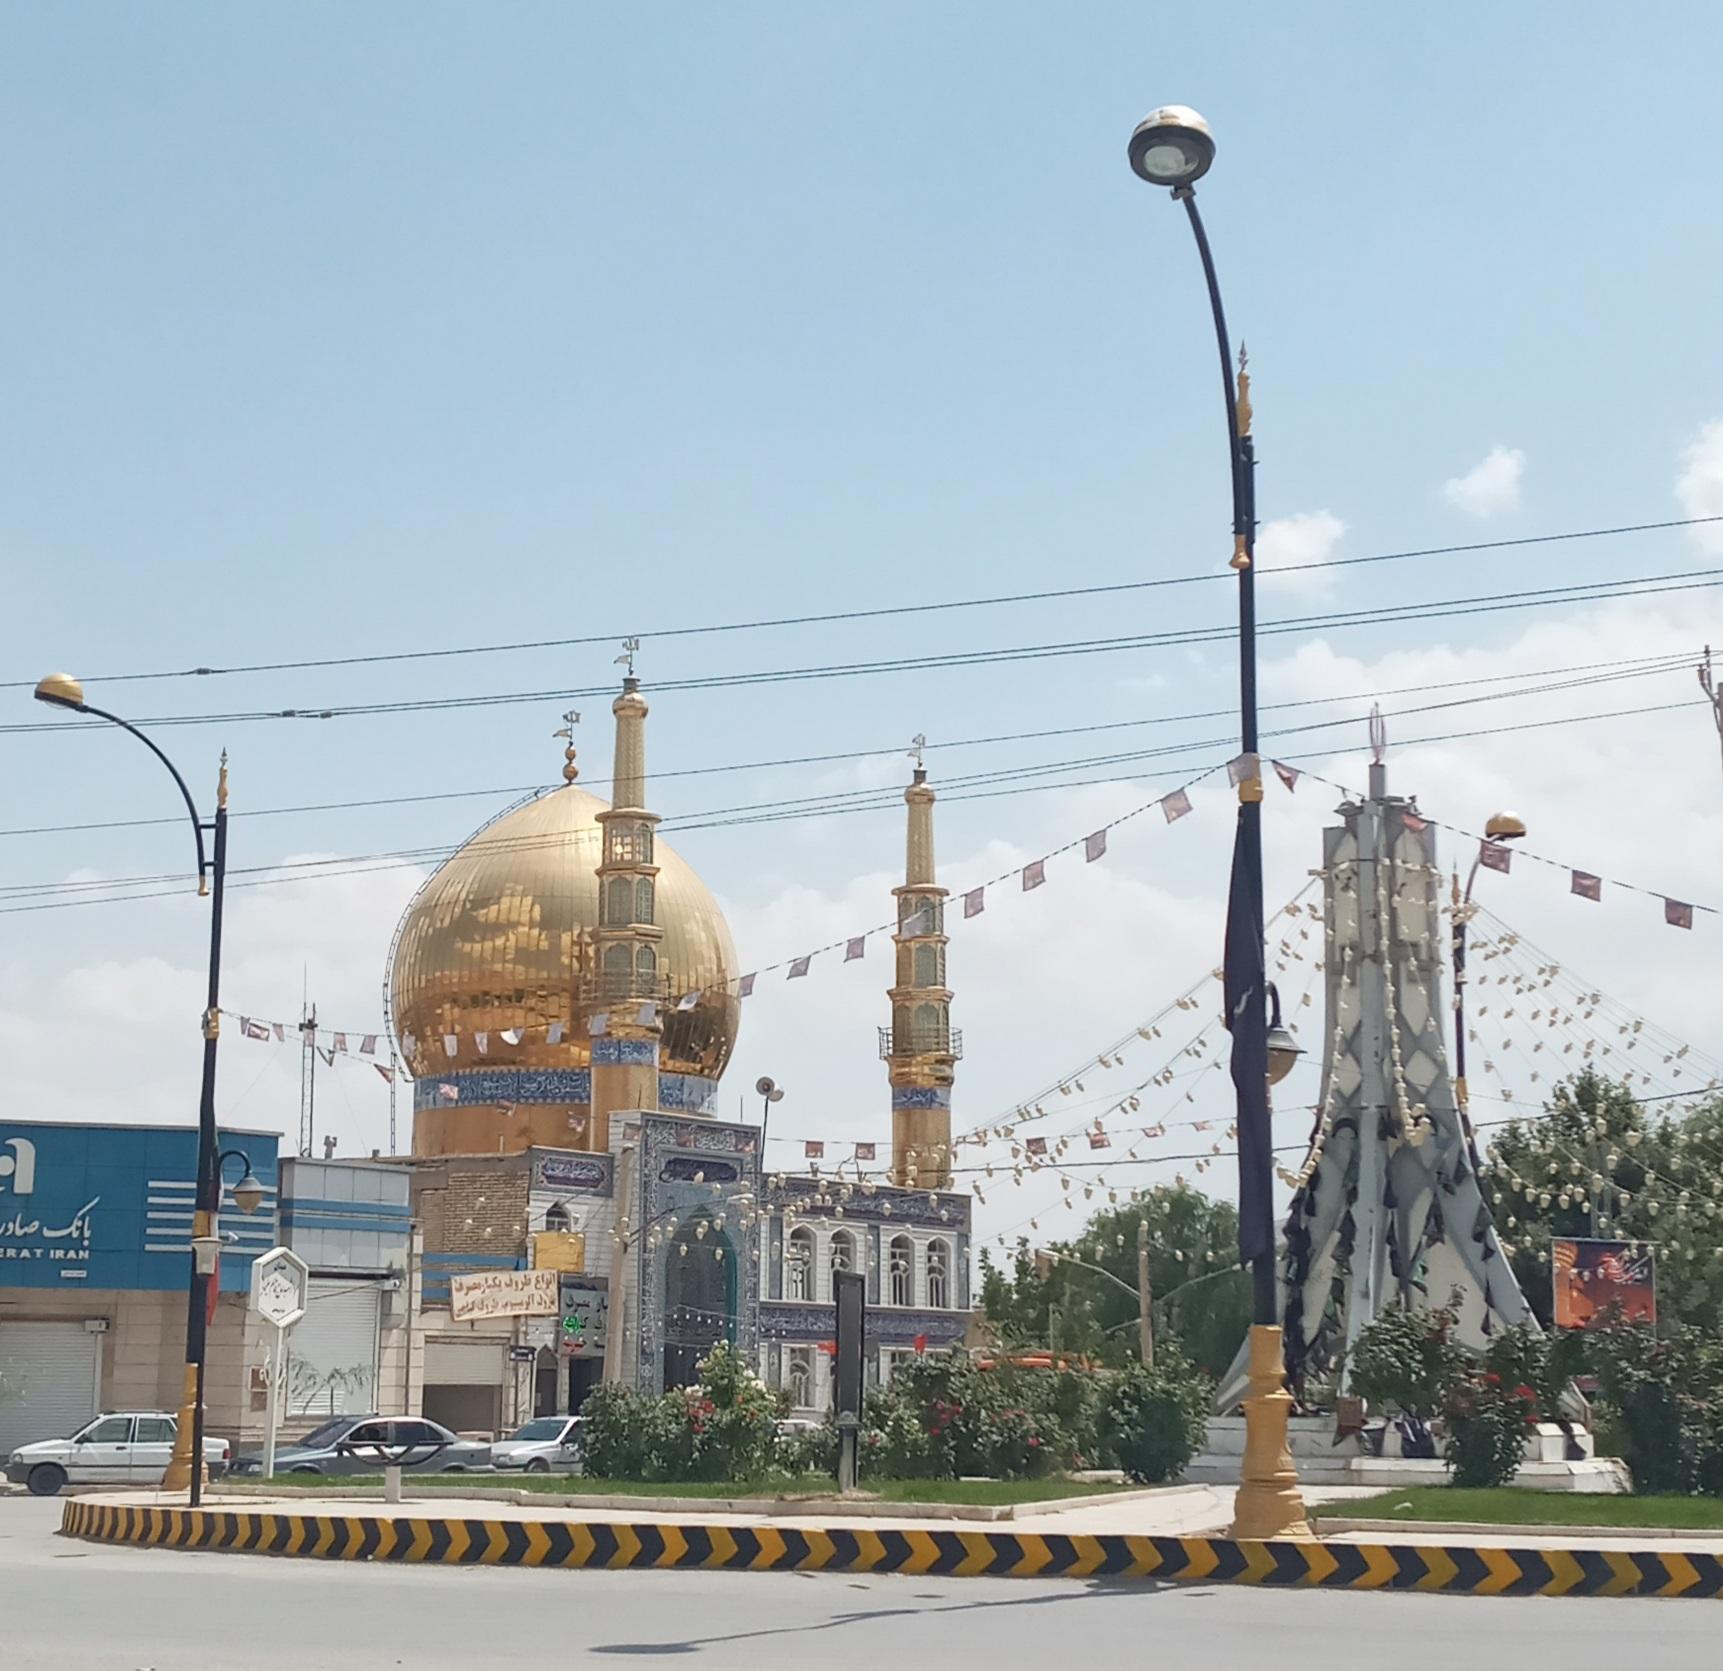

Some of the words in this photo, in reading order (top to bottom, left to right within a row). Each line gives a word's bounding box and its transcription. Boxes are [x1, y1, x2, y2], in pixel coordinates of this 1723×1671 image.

[42, 1195, 100, 1247] بانک
[50, 1249, 89, 1260] IRAN
[505, 1272, 532, 1291] ظروف
